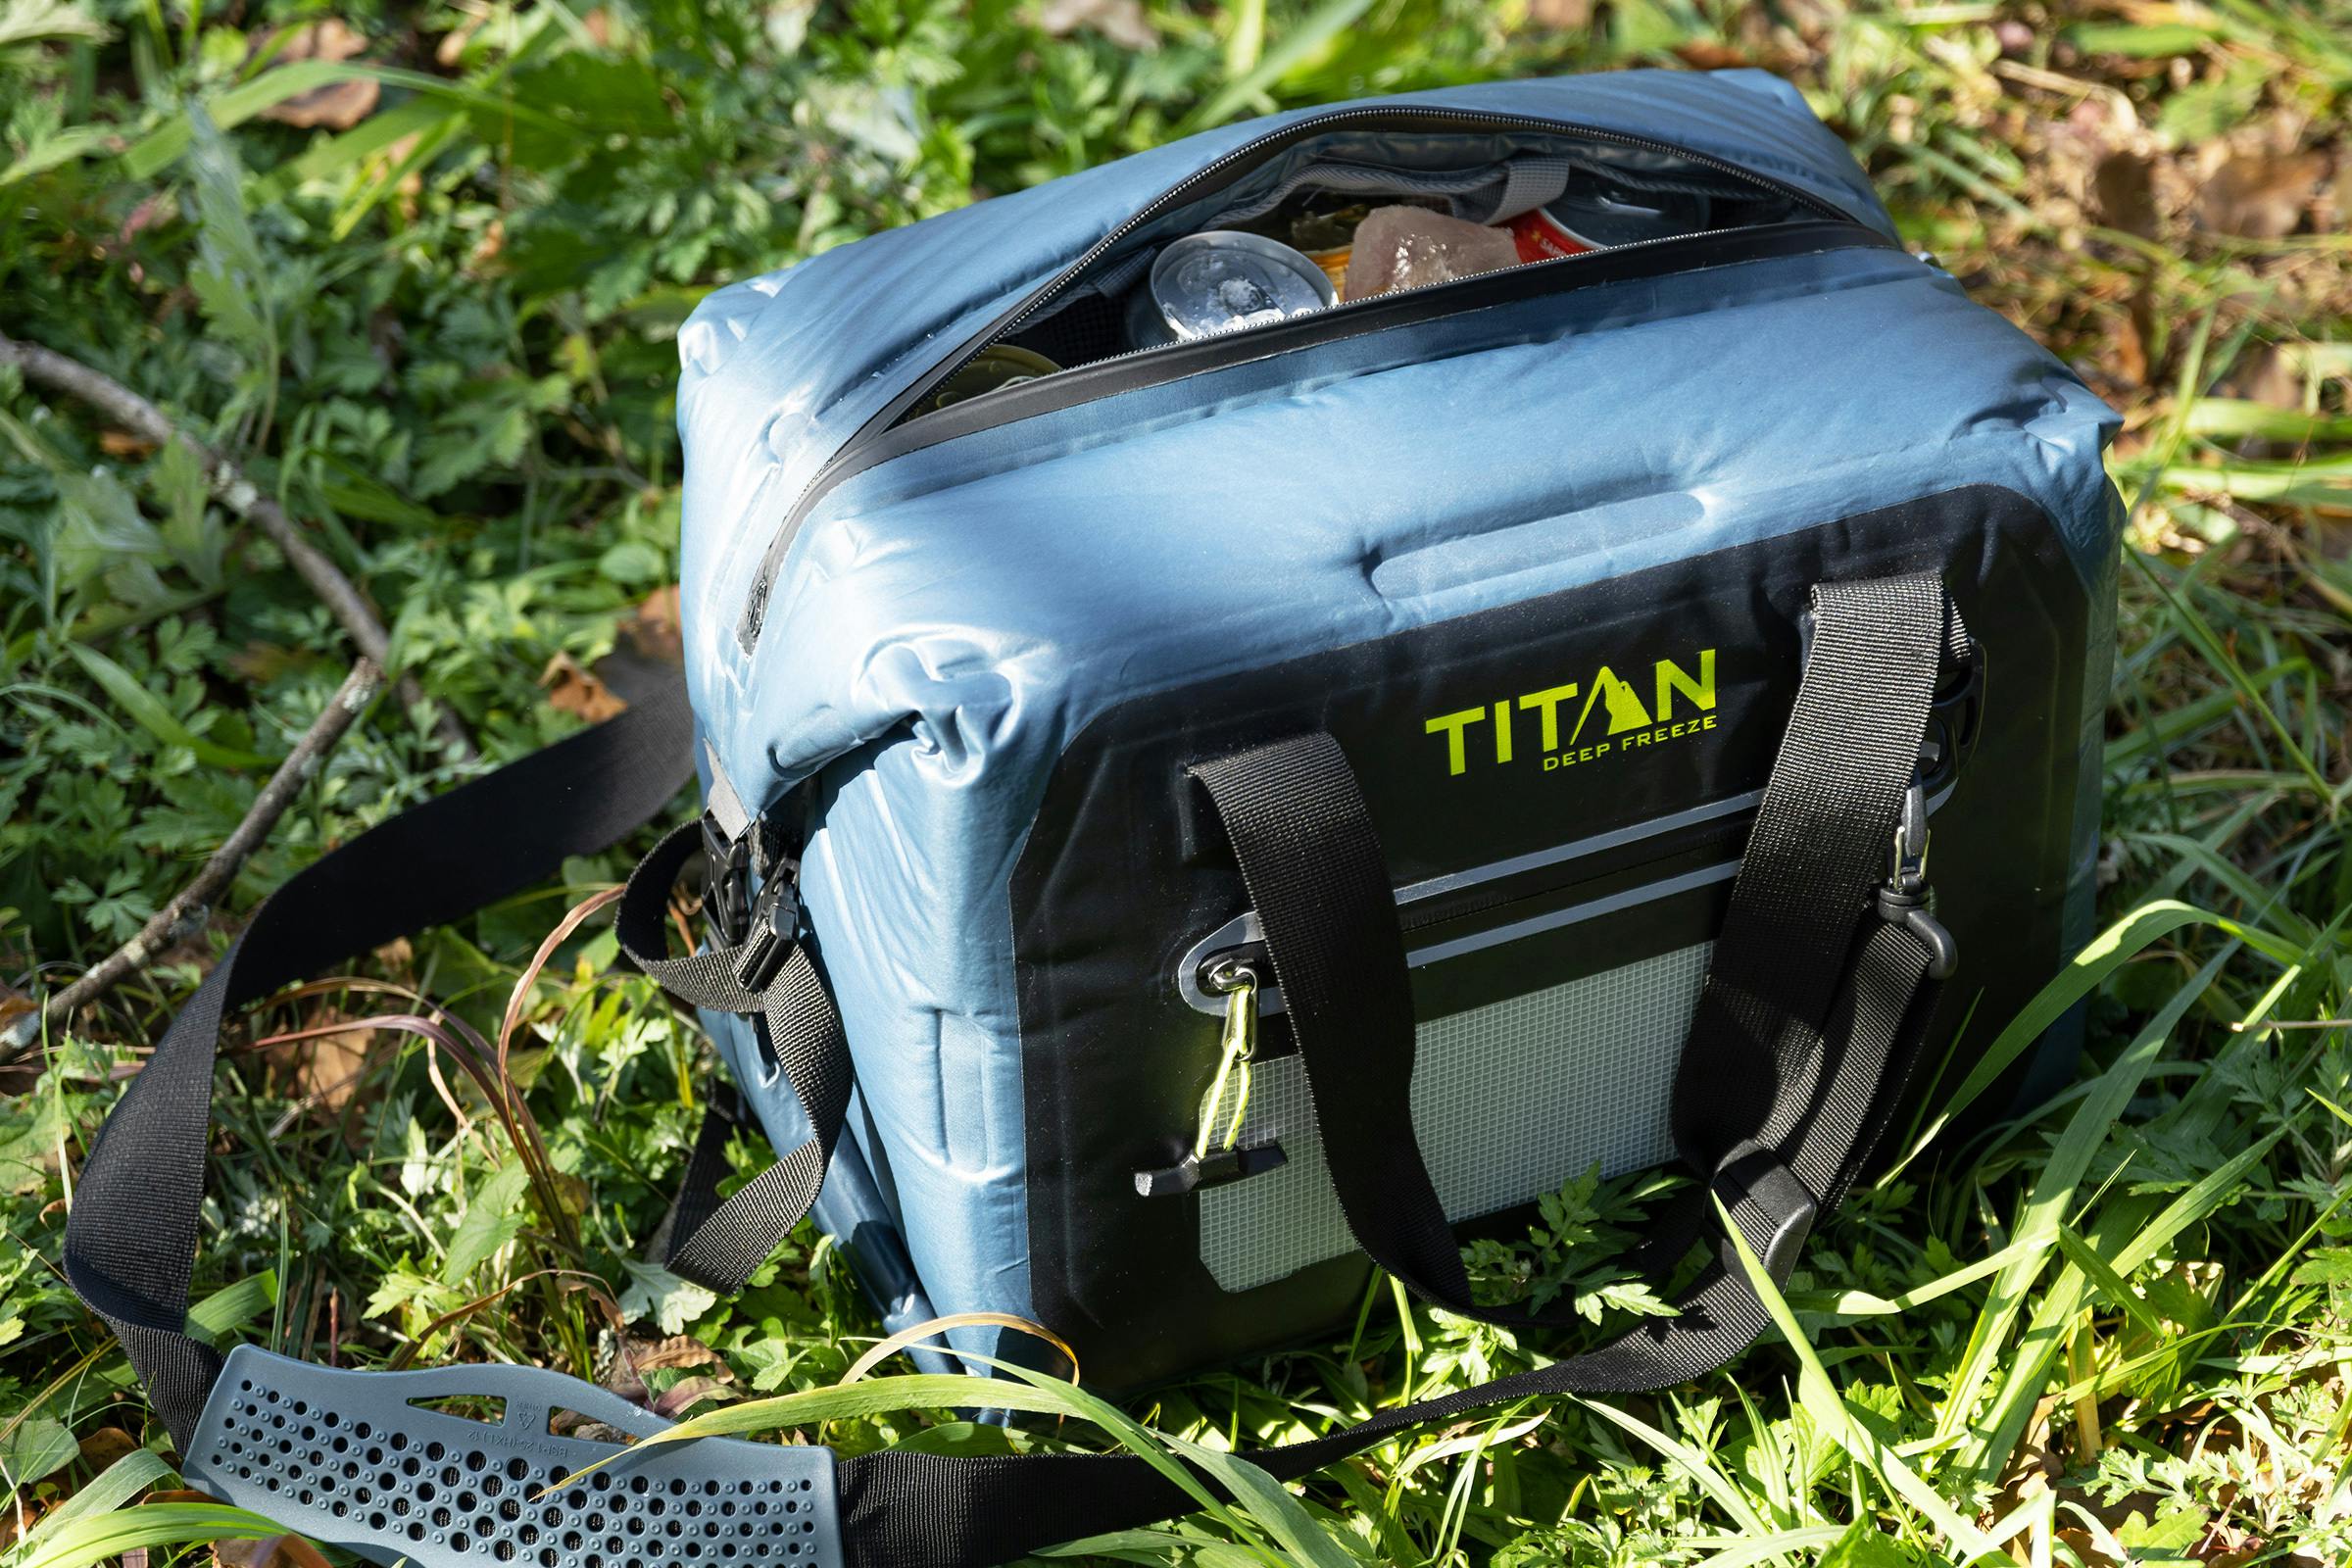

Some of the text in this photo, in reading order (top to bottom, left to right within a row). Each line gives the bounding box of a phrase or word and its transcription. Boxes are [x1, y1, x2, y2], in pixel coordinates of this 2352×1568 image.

[1425, 648, 1717, 777] TITAN
[1544, 714, 1718, 772] DEEP FREEZE
